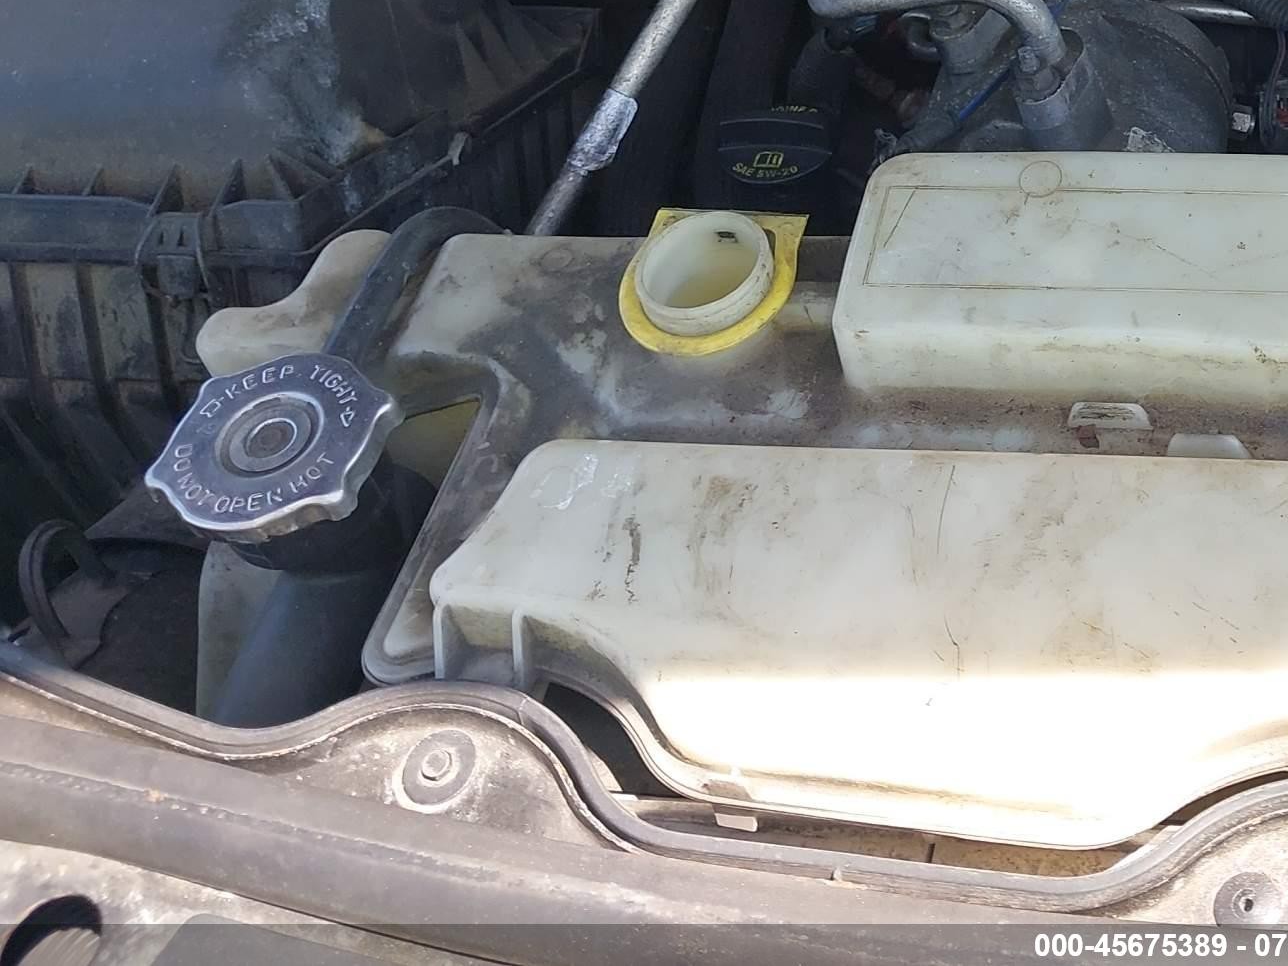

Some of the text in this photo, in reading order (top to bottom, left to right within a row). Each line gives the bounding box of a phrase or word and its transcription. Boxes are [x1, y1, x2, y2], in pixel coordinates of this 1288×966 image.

[225, 364, 358, 405] KEEP TIGHT
[173, 443, 336, 514] DO NOT OPEN HOT
